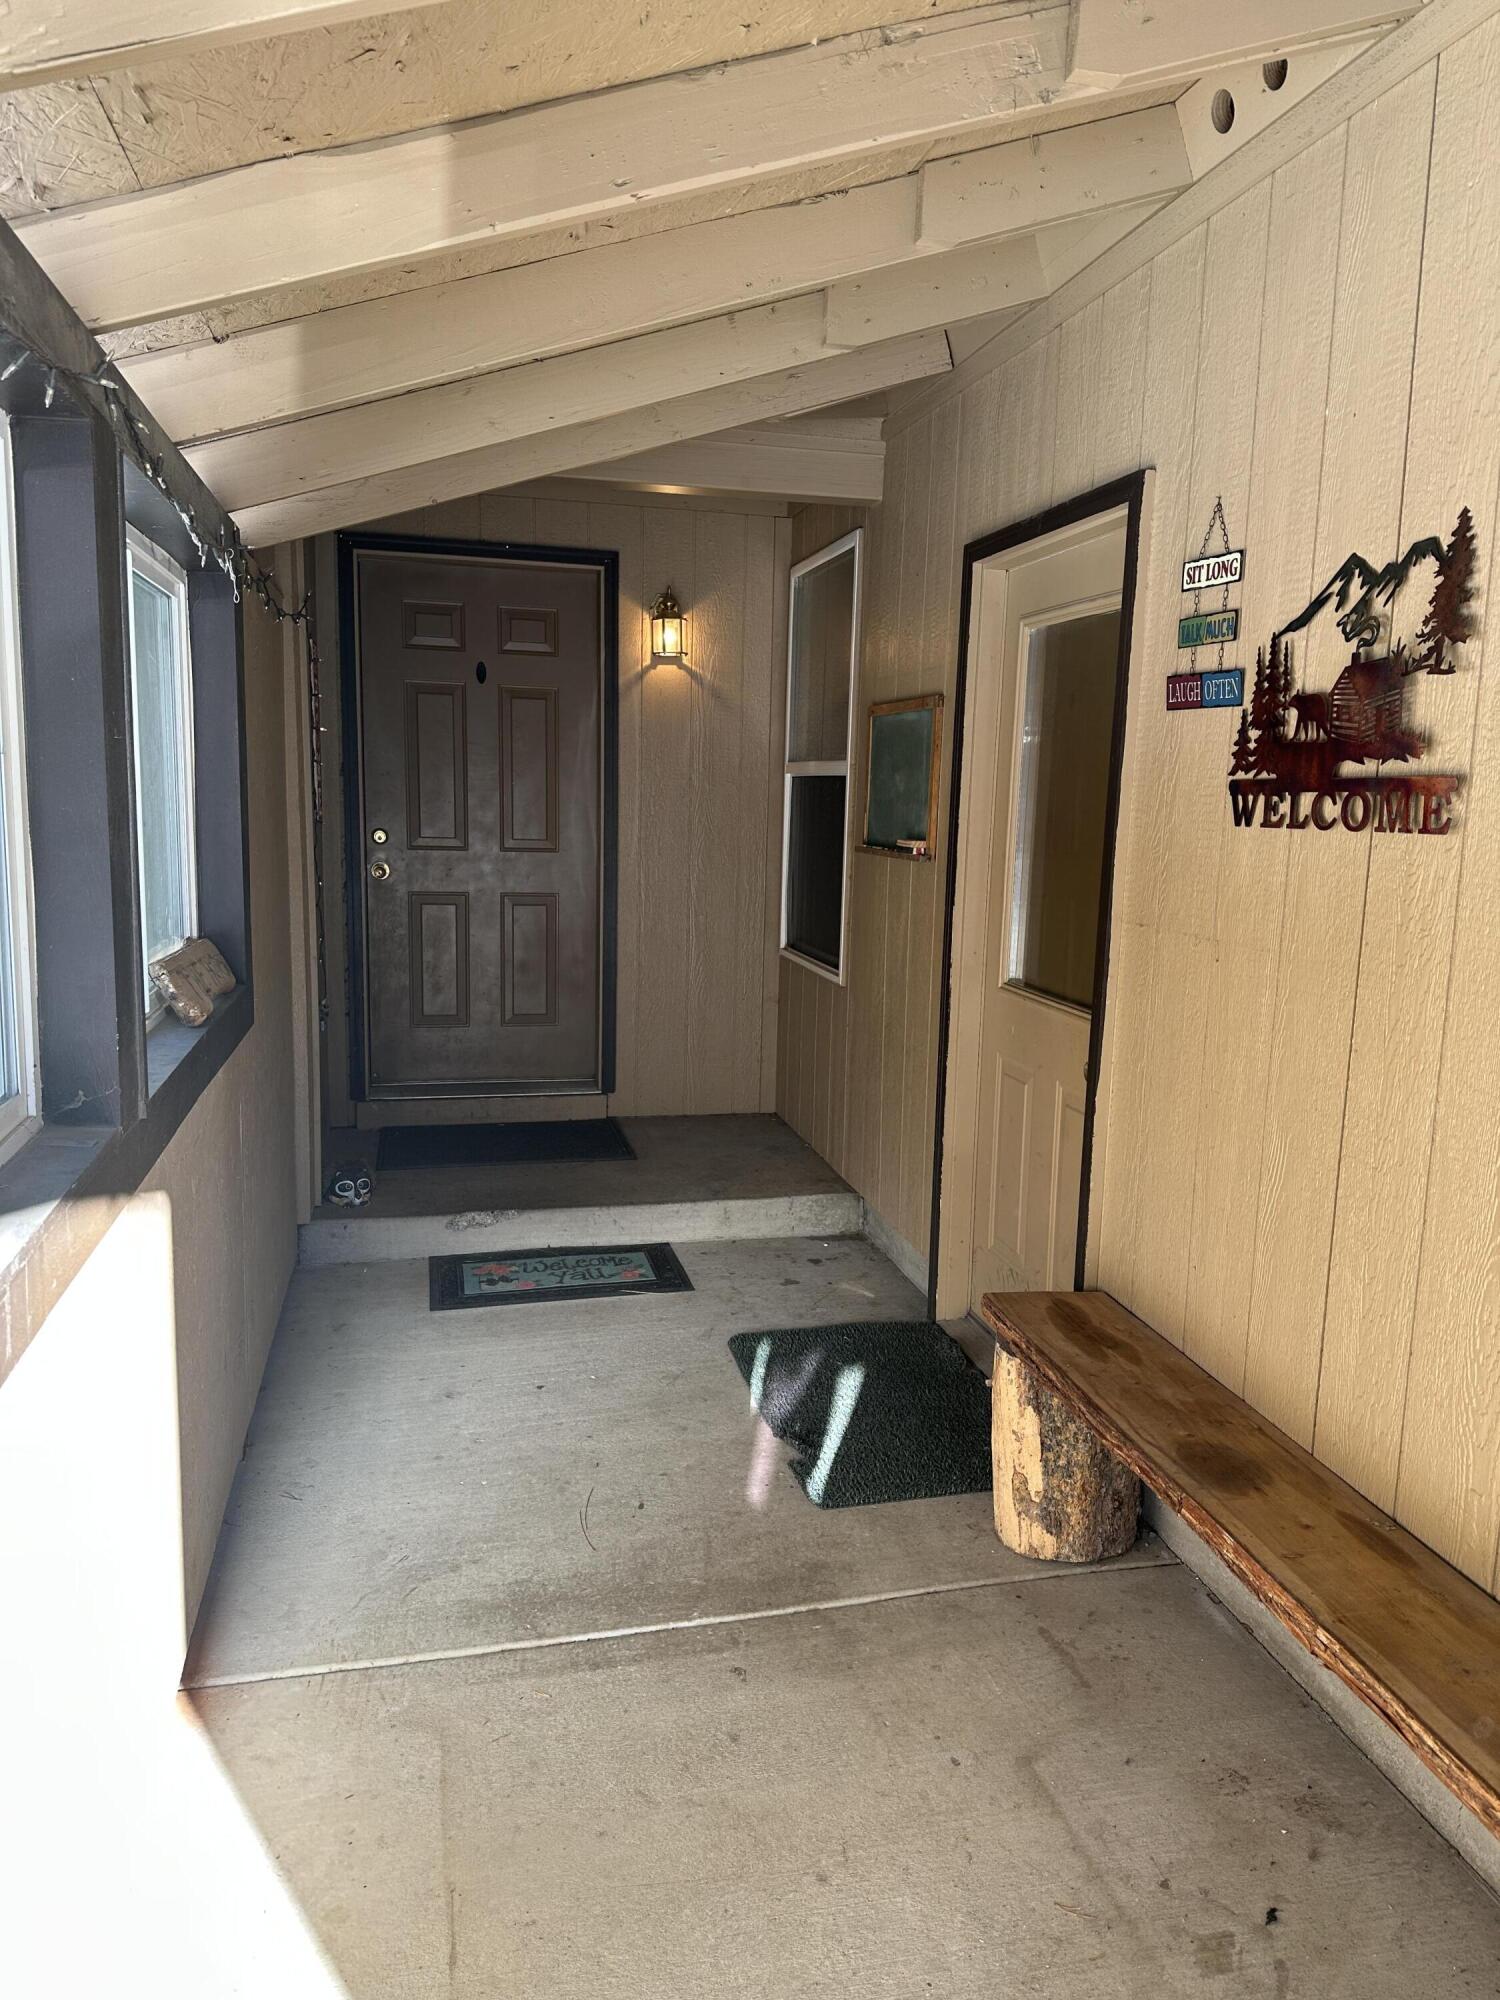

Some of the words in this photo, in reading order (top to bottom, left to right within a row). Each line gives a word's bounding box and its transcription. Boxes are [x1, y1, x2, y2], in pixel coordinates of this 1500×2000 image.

[1186, 565, 1205, 585] SIT
[1205, 558, 1239, 582] LONG
[1205, 616, 1235, 640] MUCH
[1168, 681, 1201, 703] LAUGH
[1204, 677, 1239, 700] OFTEN
[1230, 790, 1452, 835] WELCOME
